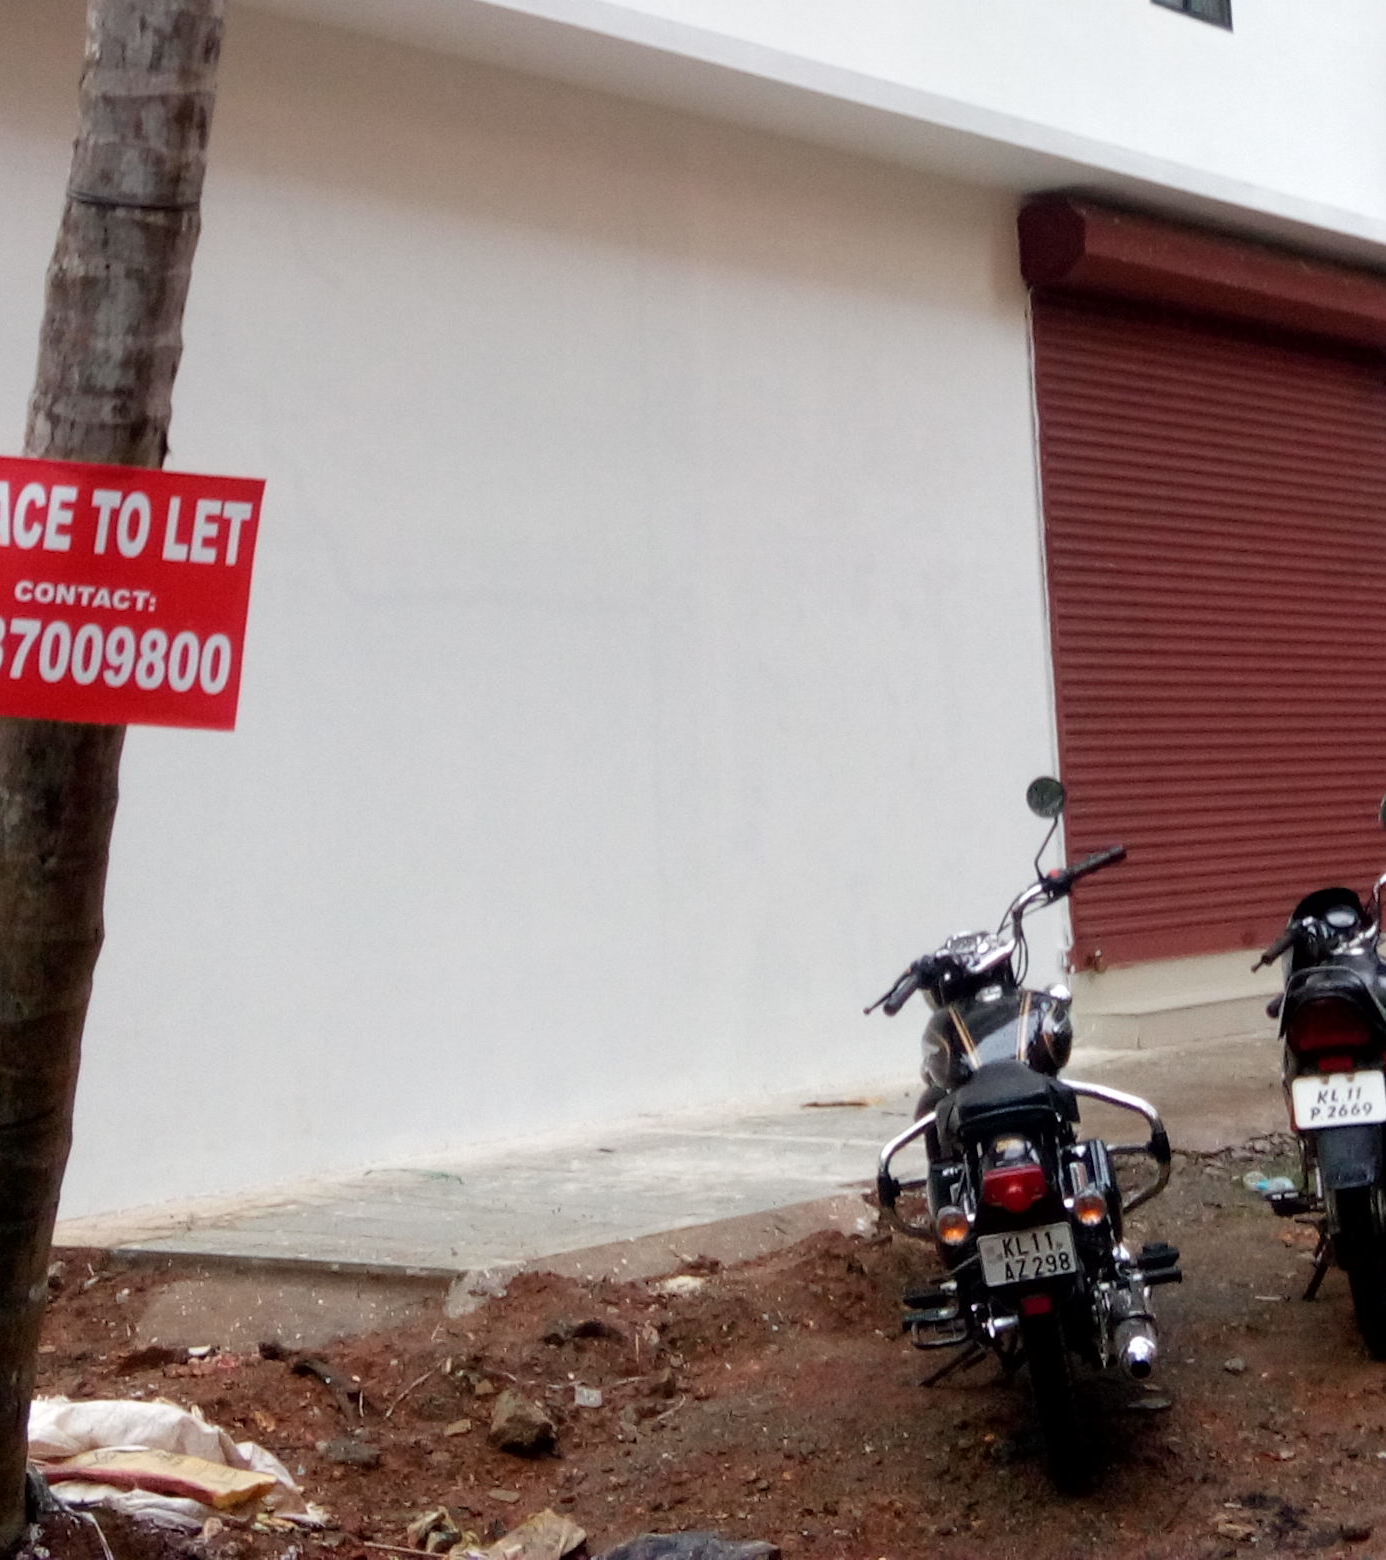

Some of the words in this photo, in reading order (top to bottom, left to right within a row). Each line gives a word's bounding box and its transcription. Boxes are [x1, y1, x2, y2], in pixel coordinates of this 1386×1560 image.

[91, 488, 152, 559] TO
[162, 495, 254, 566] LET
[14, 580, 157, 612] CONTACT:
